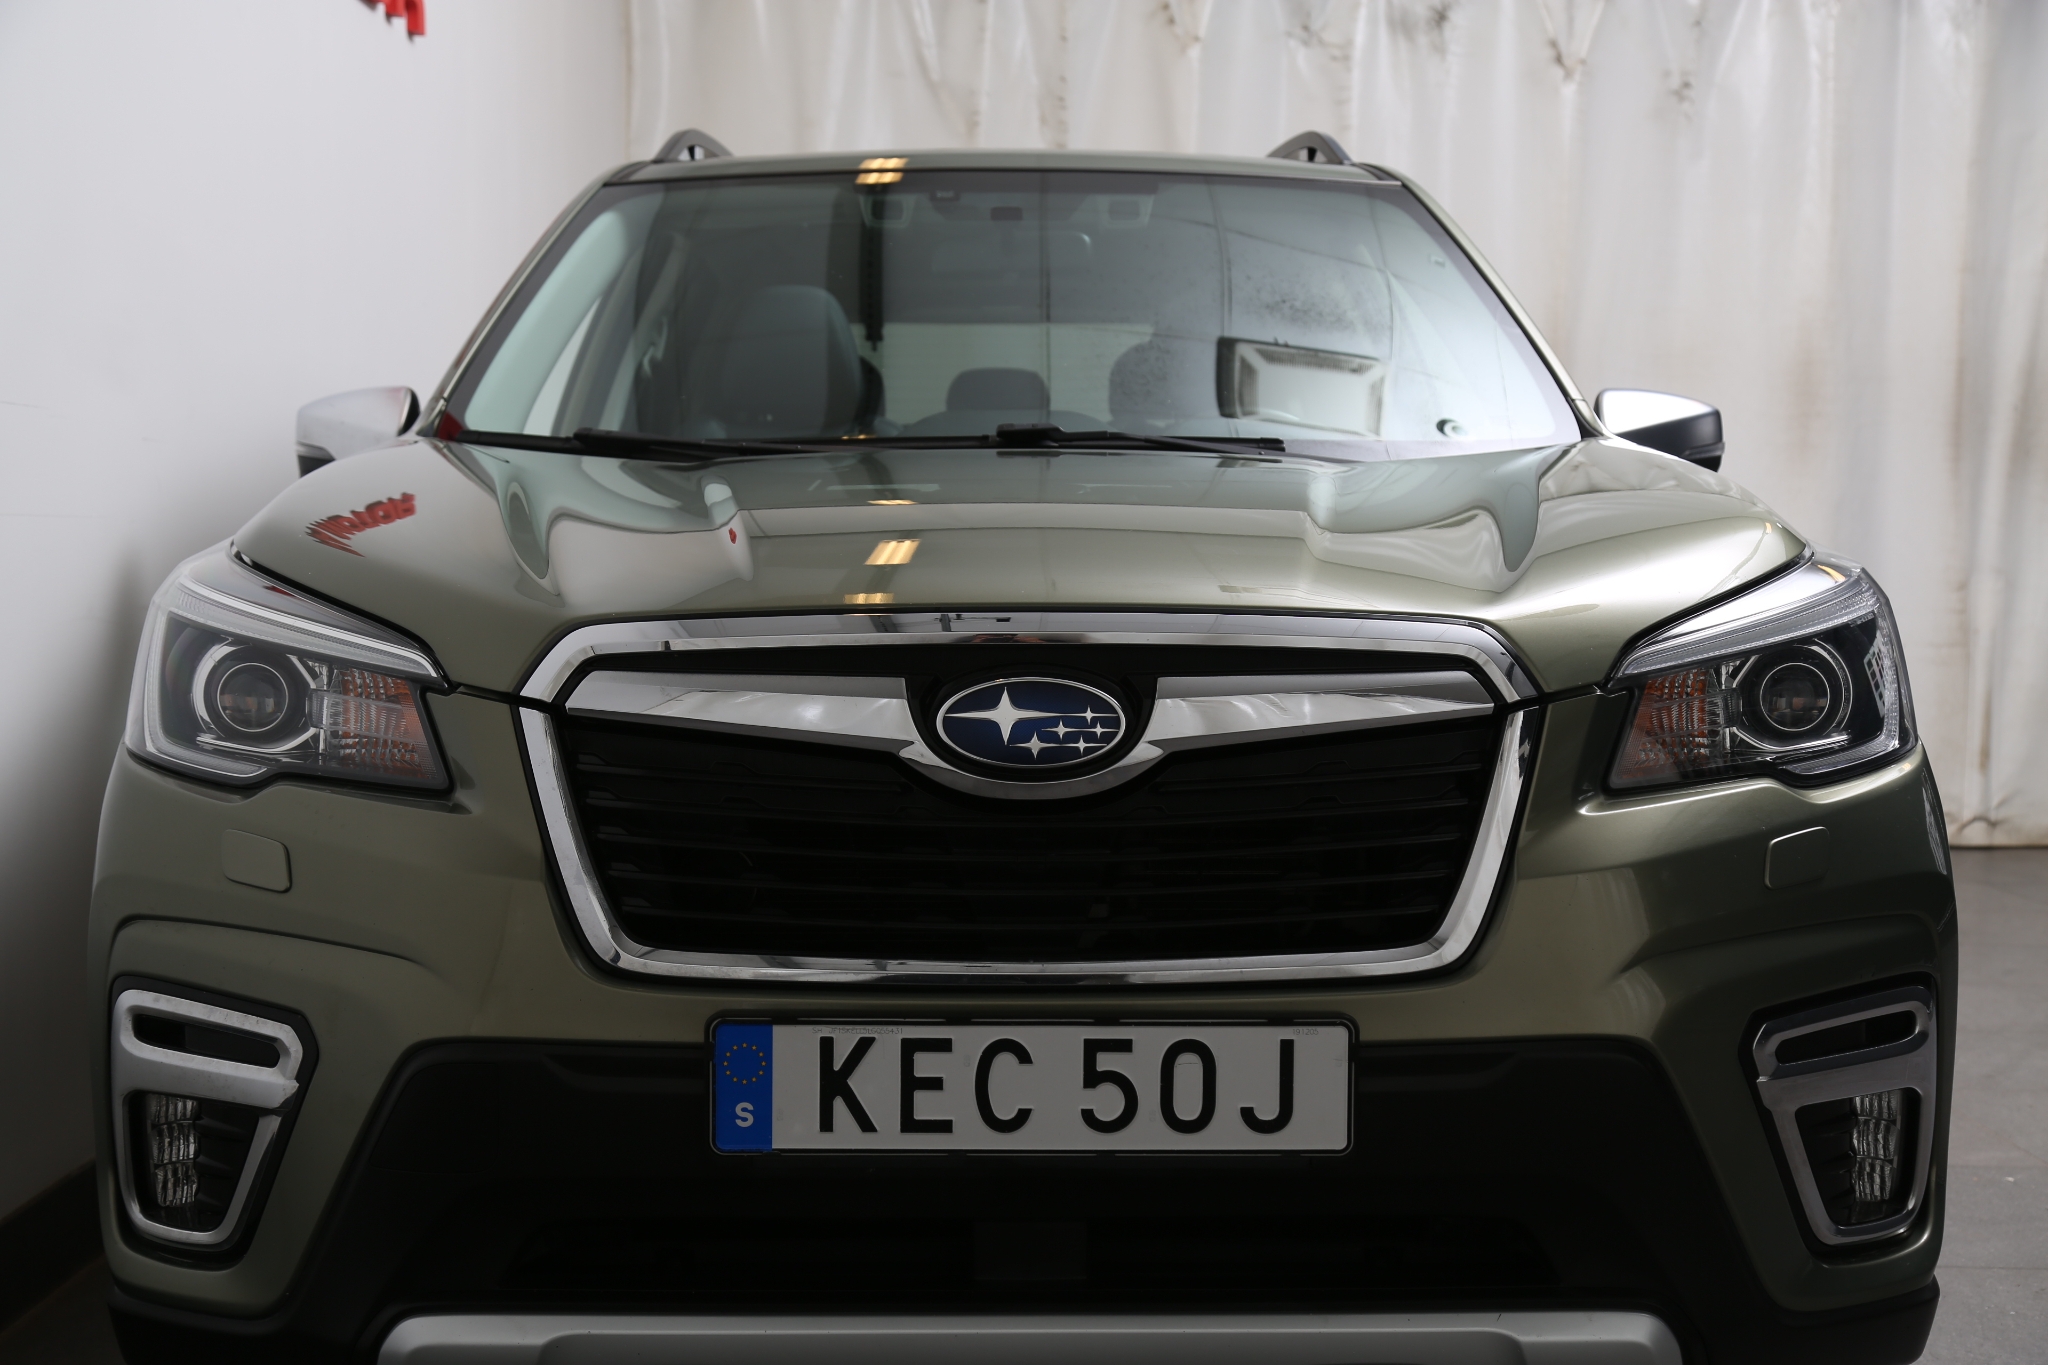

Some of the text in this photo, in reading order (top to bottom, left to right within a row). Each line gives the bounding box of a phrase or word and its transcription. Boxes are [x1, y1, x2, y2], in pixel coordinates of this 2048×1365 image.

[735, 1102, 754, 1127] S
[818, 1036, 1294, 1134] KEC 50J
